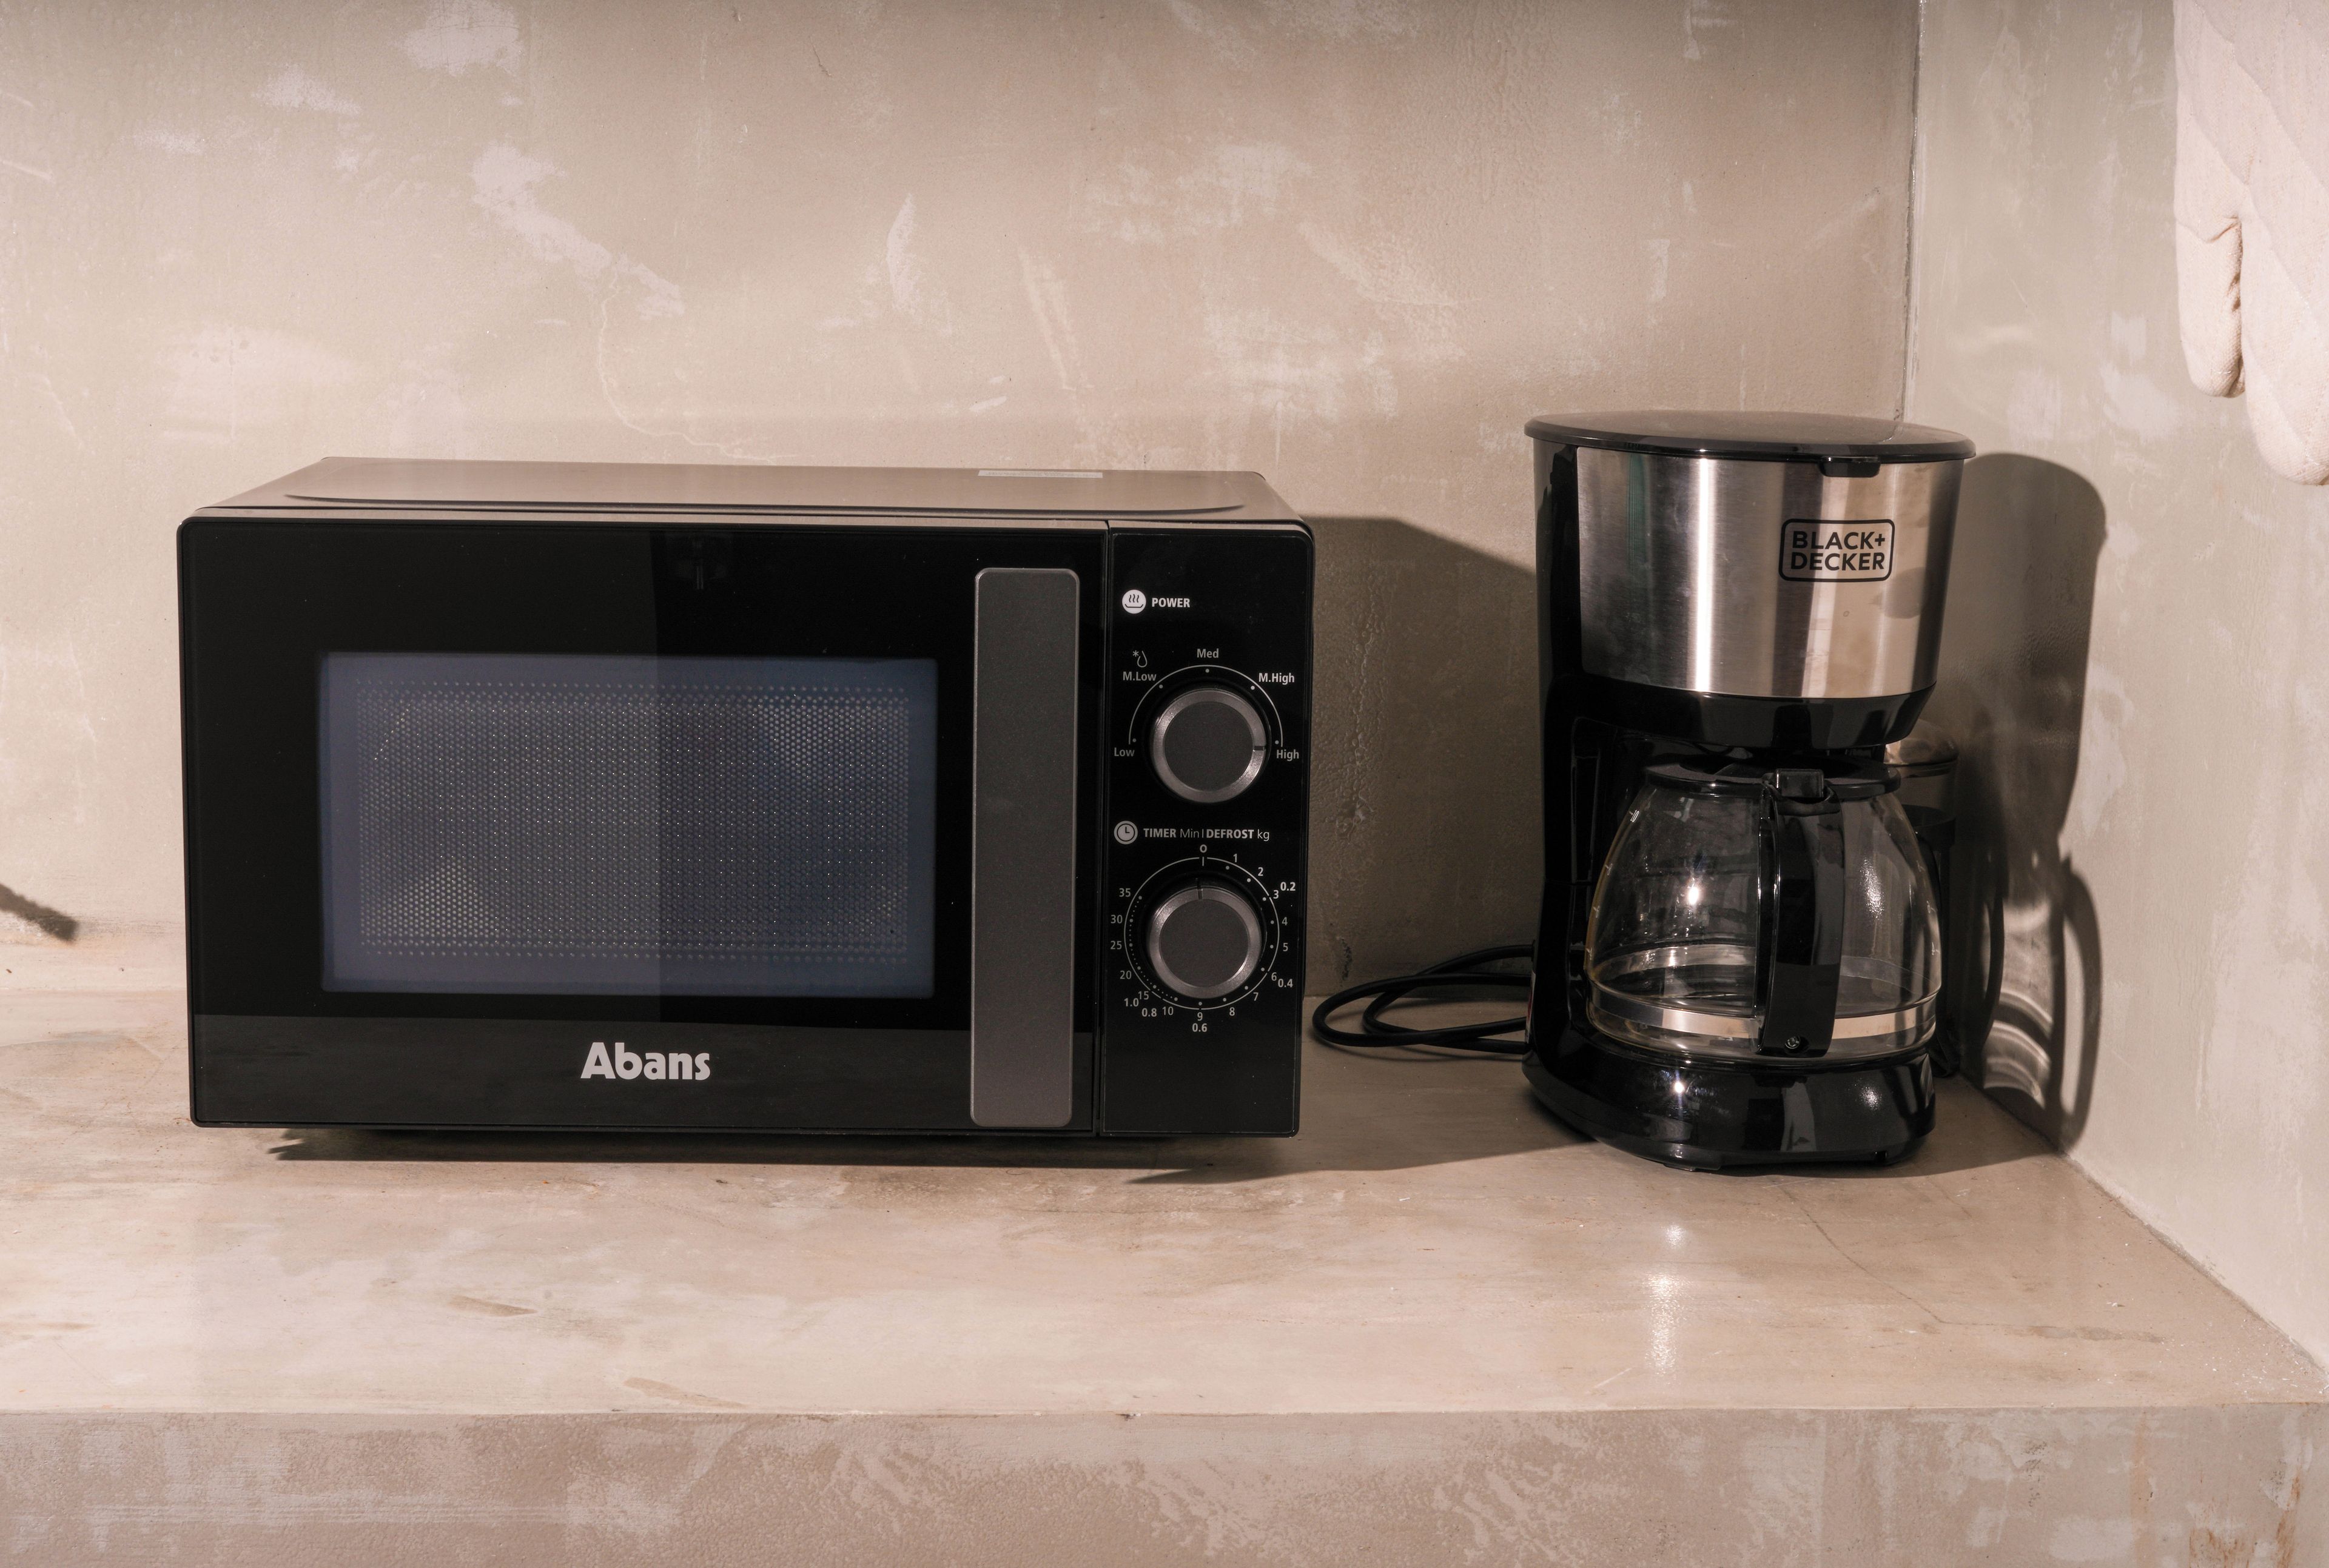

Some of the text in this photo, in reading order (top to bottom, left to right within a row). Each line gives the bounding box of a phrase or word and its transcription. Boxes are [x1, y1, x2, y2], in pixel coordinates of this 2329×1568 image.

[1790, 552, 1885, 571] DECKER
[1151, 597, 1191, 608] POWER
[1197, 648, 1219, 658] Med
[1123, 671, 1157, 682] M.Low
[1258, 672, 1296, 685] M.High
[1114, 747, 1135, 757] Low
[1276, 749, 1299, 762] High
[1143, 828, 1177, 838] TIMER
[1180, 828, 1200, 838] Min
[1206, 829, 1255, 839] DEFROST
[1257, 829, 1269, 842] kg
[1232, 853, 1238, 863] 1
[1257, 866, 1264, 877] 2
[1280, 881, 1296, 891] 0.2
[1119, 888, 1131, 897] 35
[1273, 890, 1279, 899] 3
[1111, 914, 1123, 924] 30
[1281, 916, 1288, 926] 4
[1110, 940, 1122, 950] 25
[1283, 942, 1288, 952] 5
[1120, 970, 1132, 980] 20
[1271, 971, 1277, 982] 6
[1277, 978, 1294, 988] 0.4
[1138, 991, 1149, 1000] 15
[1252, 992, 1260, 1002] 7
[1124, 997, 1140, 1007] 1.0
[1141, 1008, 1157, 1017] 0.8
[1162, 1006, 1174, 1016] 10
[1229, 1007, 1235, 1016] 8
[1197, 1011, 1203, 1022] 9
[1192, 1022, 1208, 1033] 0.6
[580, 1042, 711, 1081] Abans
